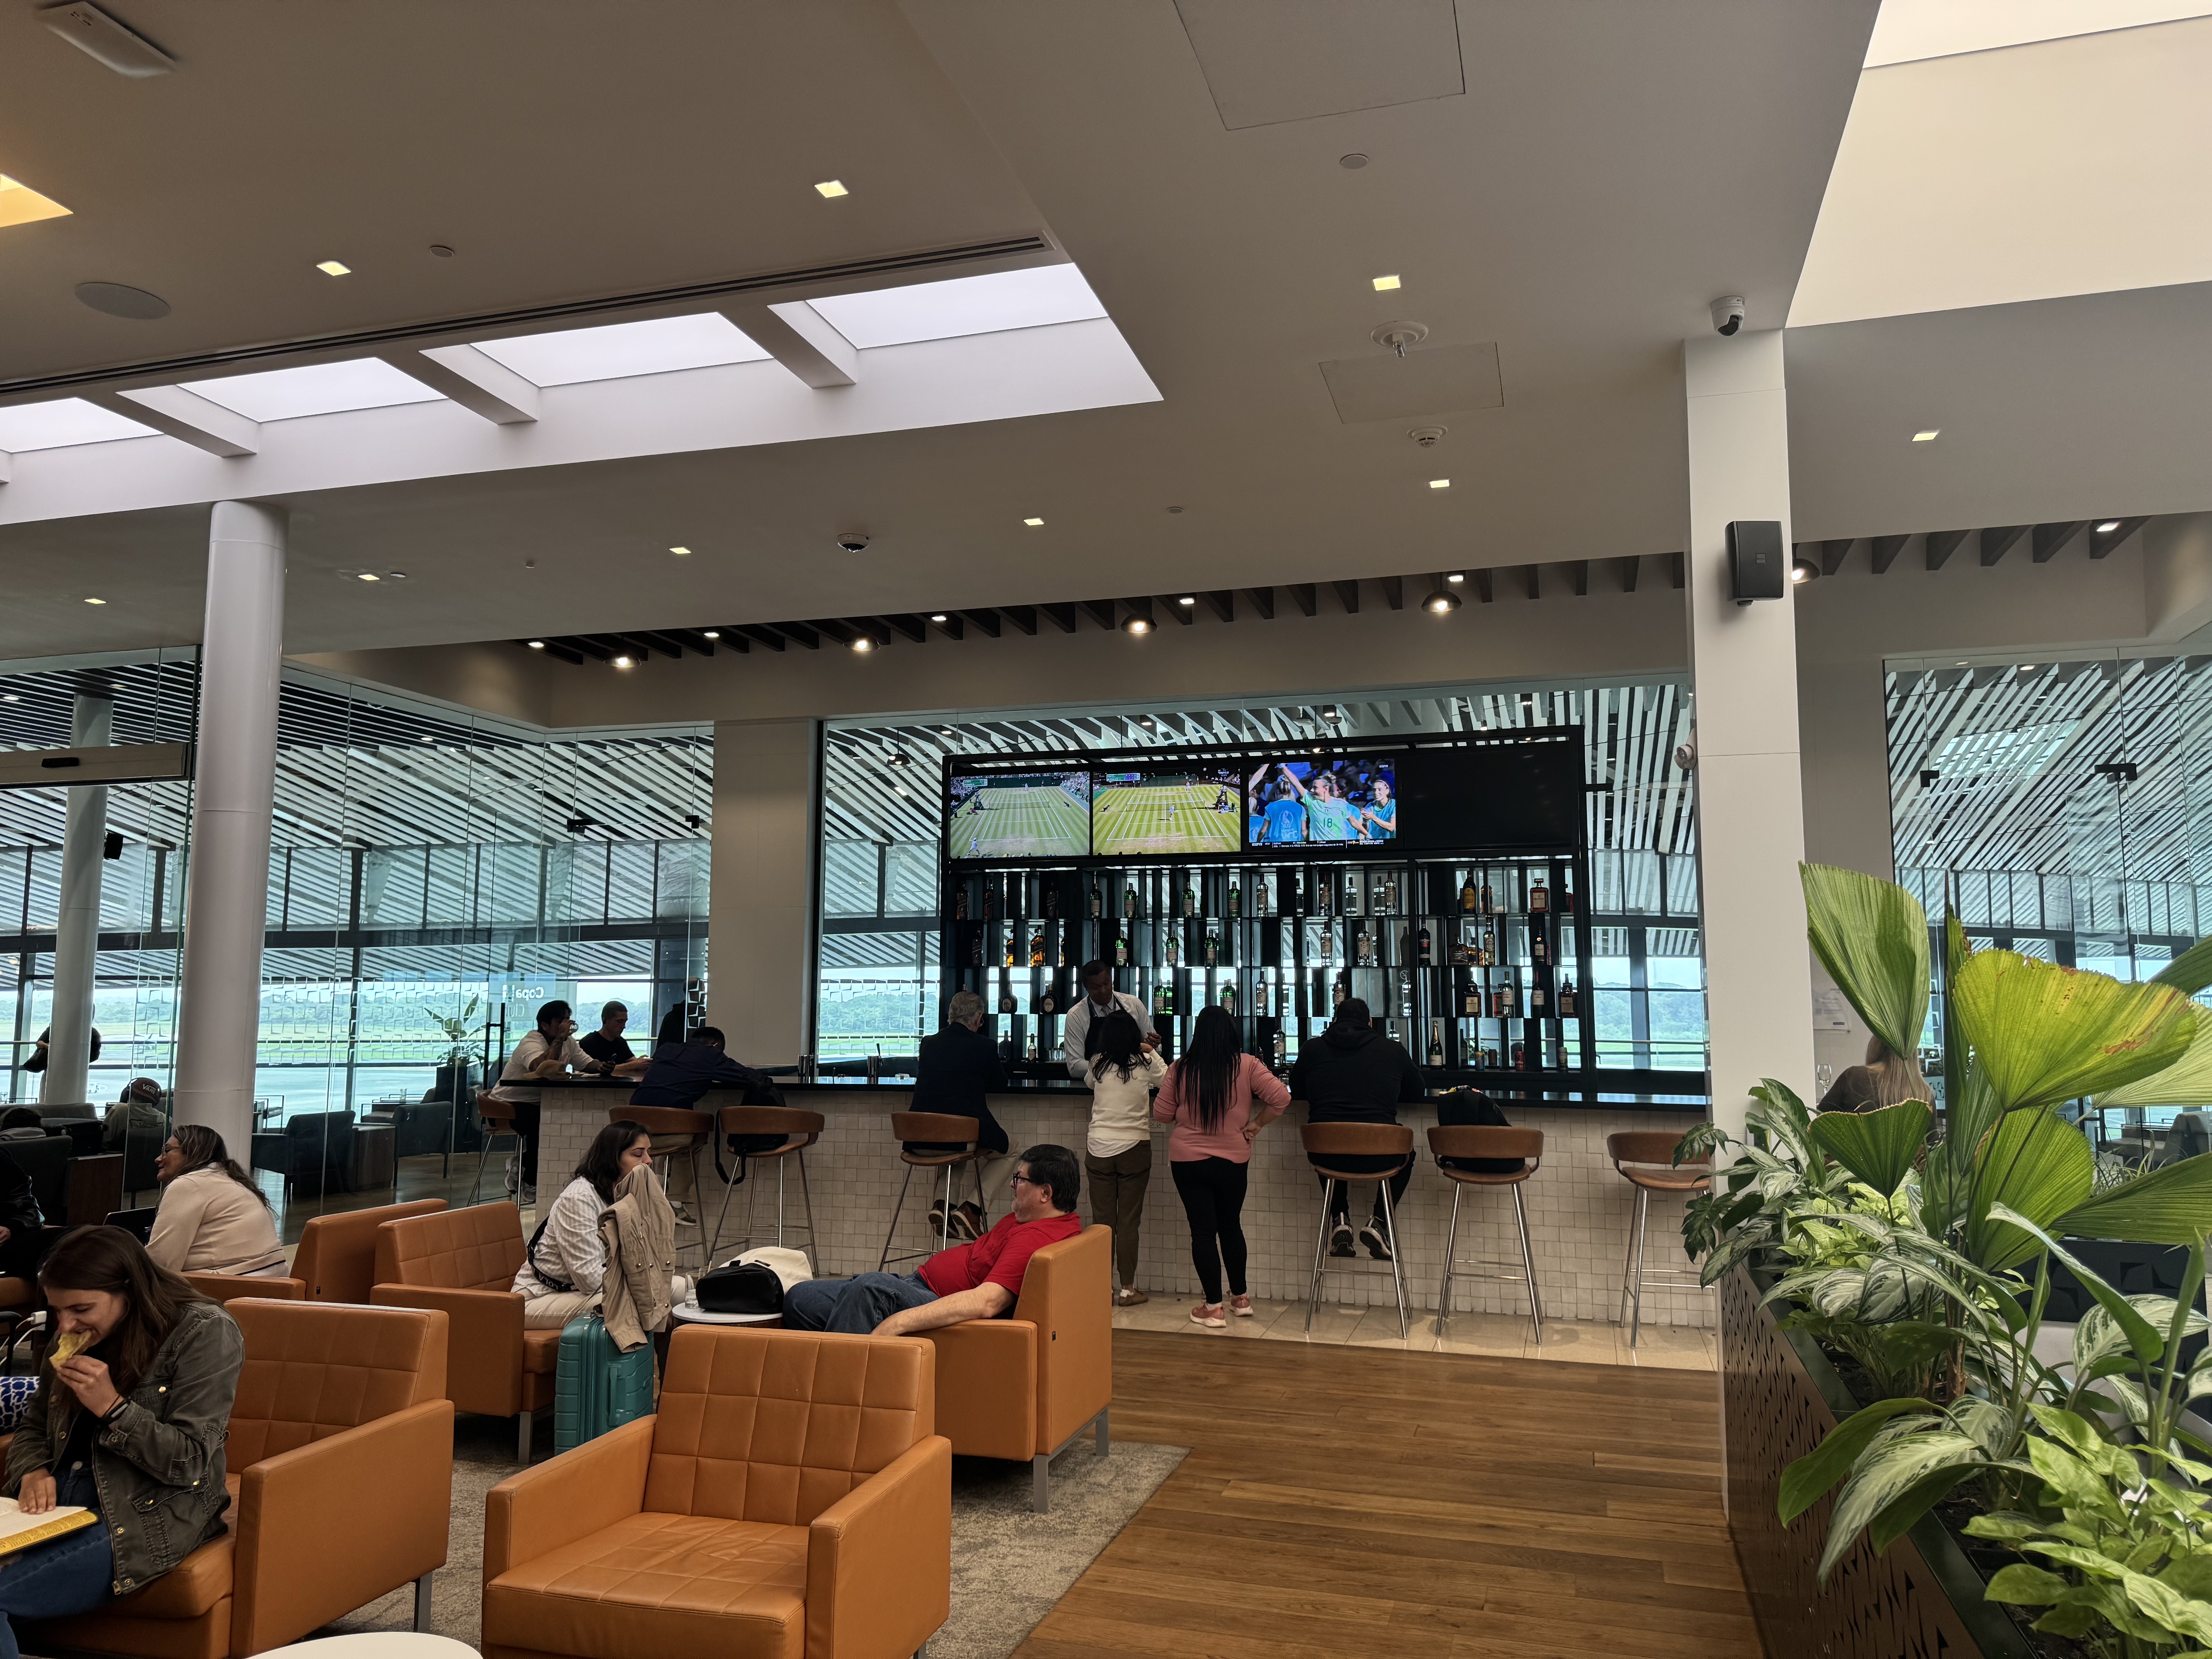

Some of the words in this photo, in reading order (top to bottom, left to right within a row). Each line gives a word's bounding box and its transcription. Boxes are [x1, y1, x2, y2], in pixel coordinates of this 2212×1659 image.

[1324, 817, 1333, 828] 18
[143, 1084, 156, 1094] VANS
[539, 1273, 558, 1290] LOLA
